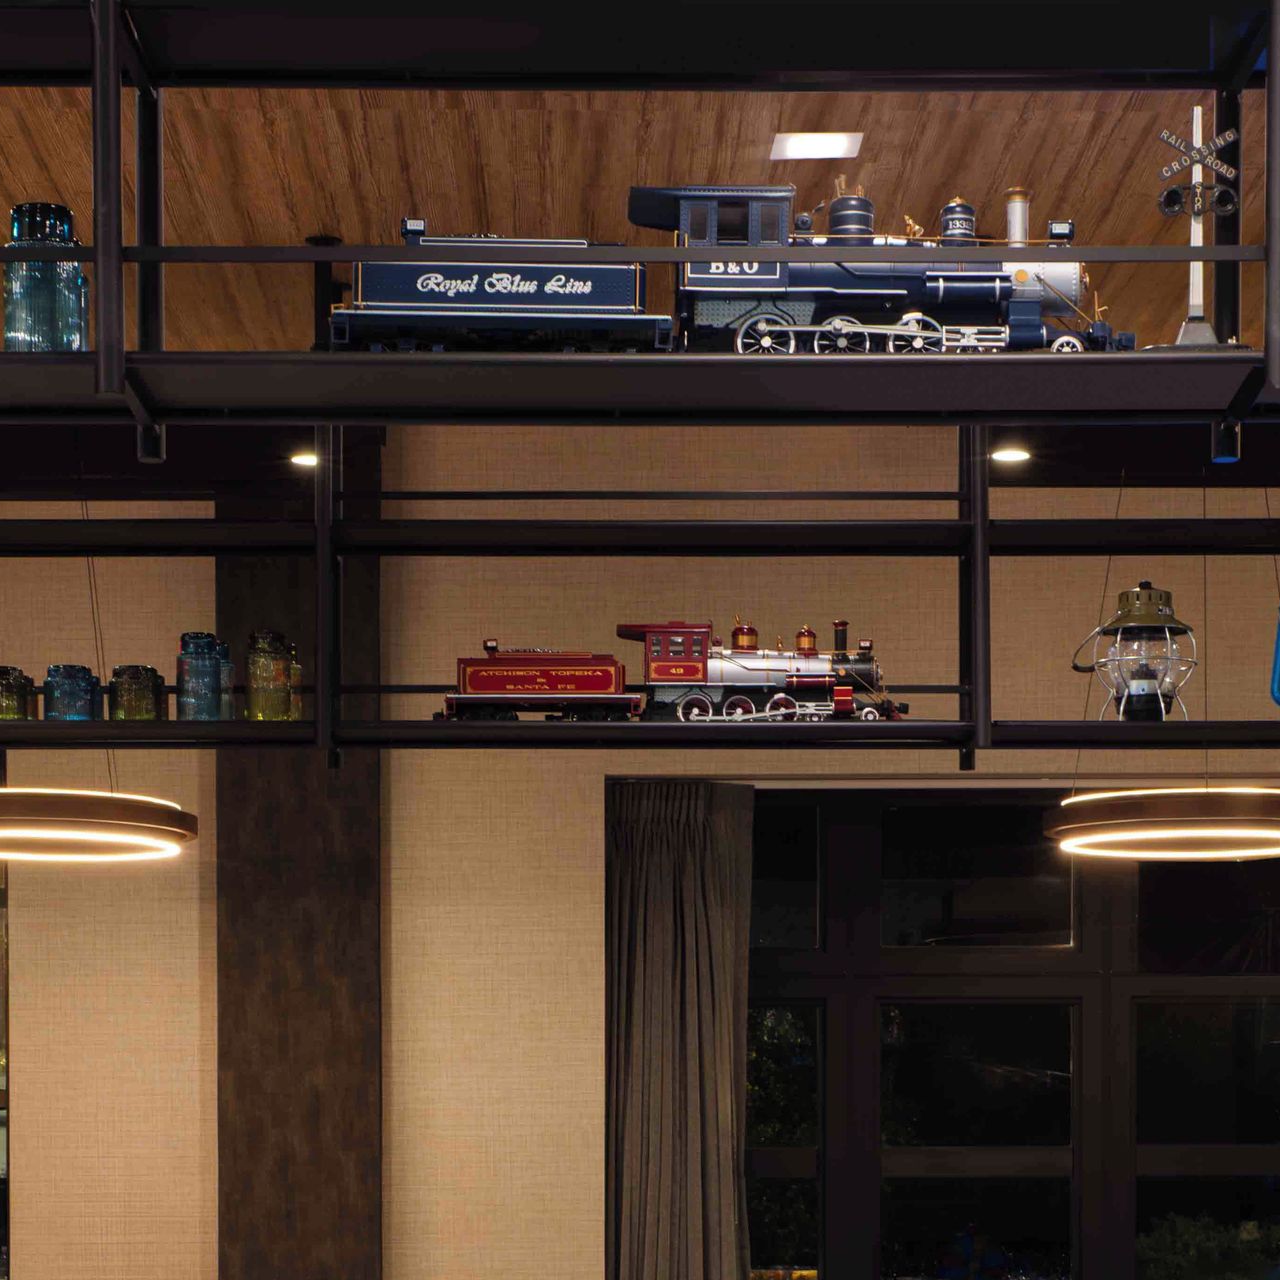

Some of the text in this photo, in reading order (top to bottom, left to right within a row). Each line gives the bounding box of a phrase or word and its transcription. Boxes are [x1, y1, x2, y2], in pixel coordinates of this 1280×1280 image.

[1160, 129, 1236, 178] RAIL ROAD
[1162, 131, 1234, 177] CROSSING
[416, 272, 593, 297] Royal Blue Line
